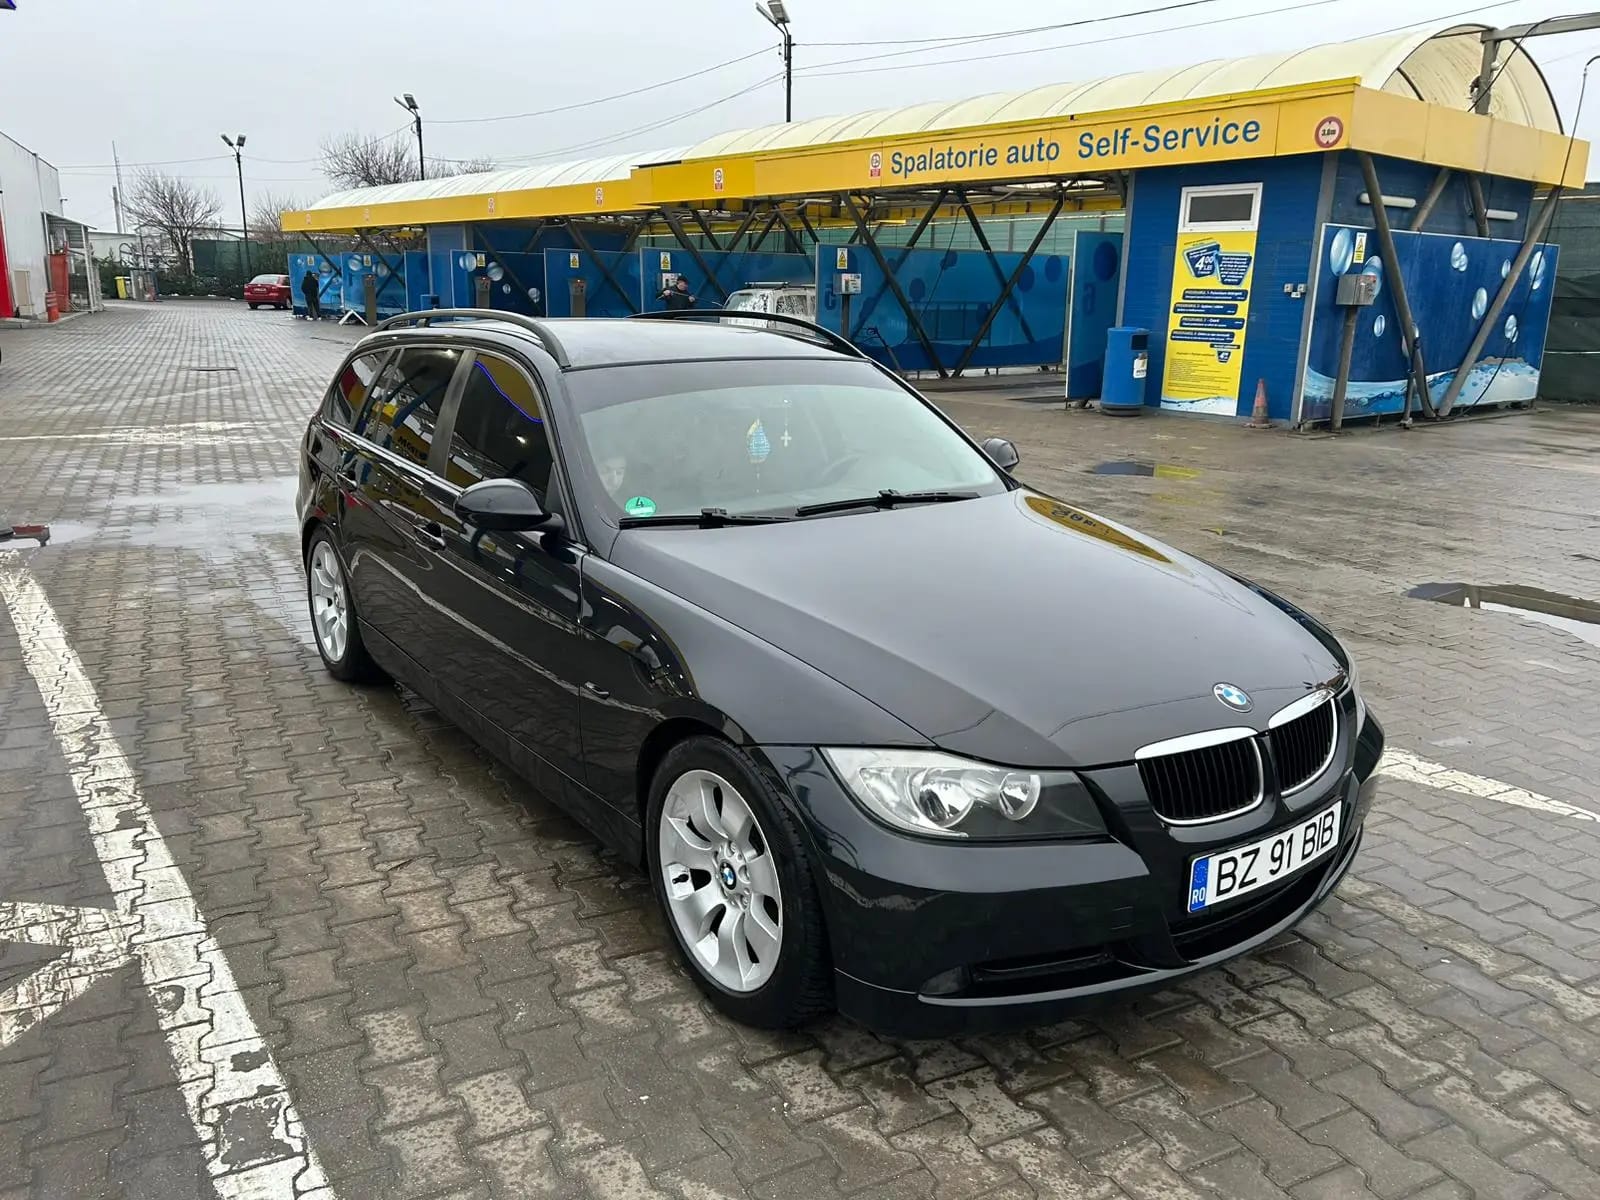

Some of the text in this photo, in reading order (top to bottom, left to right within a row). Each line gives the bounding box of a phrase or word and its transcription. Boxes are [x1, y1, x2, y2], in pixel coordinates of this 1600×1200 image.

[891, 117, 1261, 179] Spalatorie auto Self-Service
[635, 496, 644, 508] 4
[1215, 810, 1335, 897] BZ 91 BIB
[1191, 886, 1206, 905] RO
